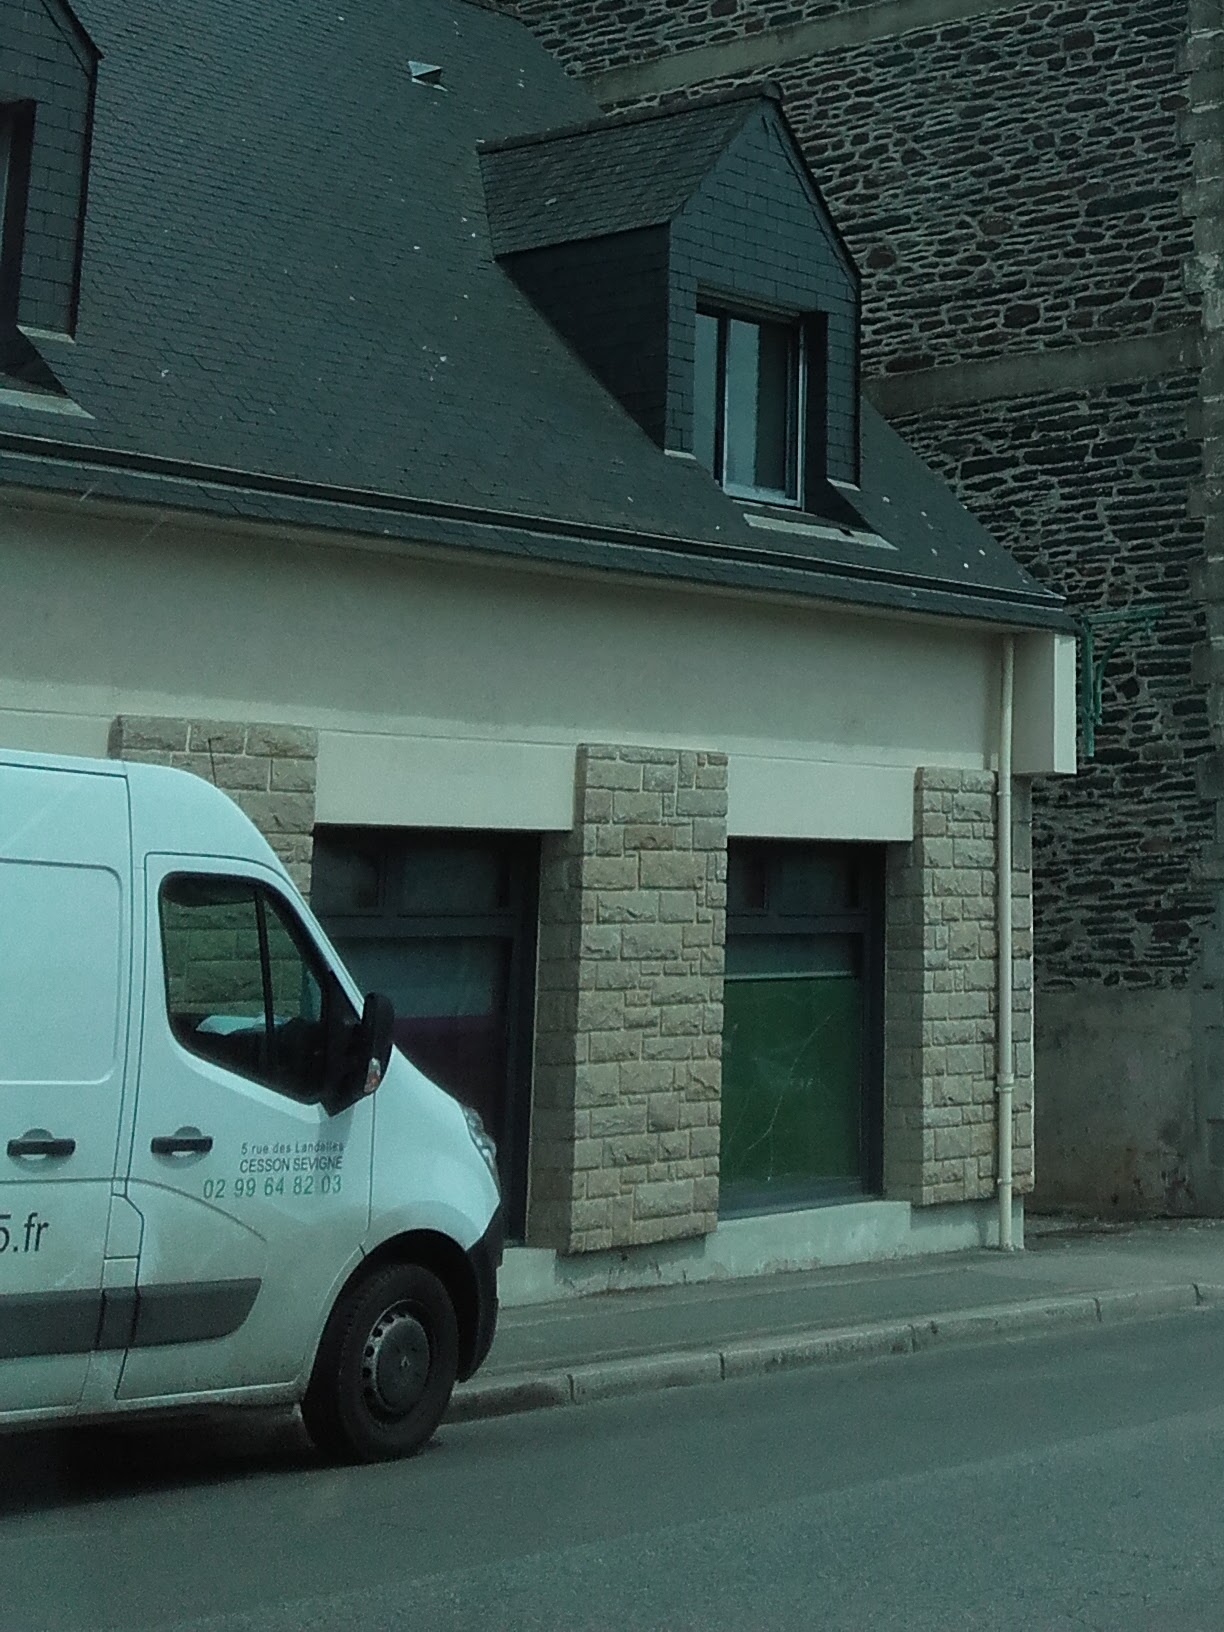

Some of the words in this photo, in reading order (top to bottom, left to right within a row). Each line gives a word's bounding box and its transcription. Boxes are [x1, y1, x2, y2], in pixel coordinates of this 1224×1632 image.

[241, 1142, 248, 1155] 5
[252, 1145, 269, 1154] rue
[272, 1142, 291, 1154] des
[240, 1157, 290, 1173] CESSON
[293, 1155, 343, 1171] SEVIGNE
[203, 1179, 226, 1199] 02
[234, 1177, 256, 1197] 99
[264, 1176, 285, 1196] 64
[293, 1175, 314, 1195] 82
[321, 1174, 342, 1194] 03
